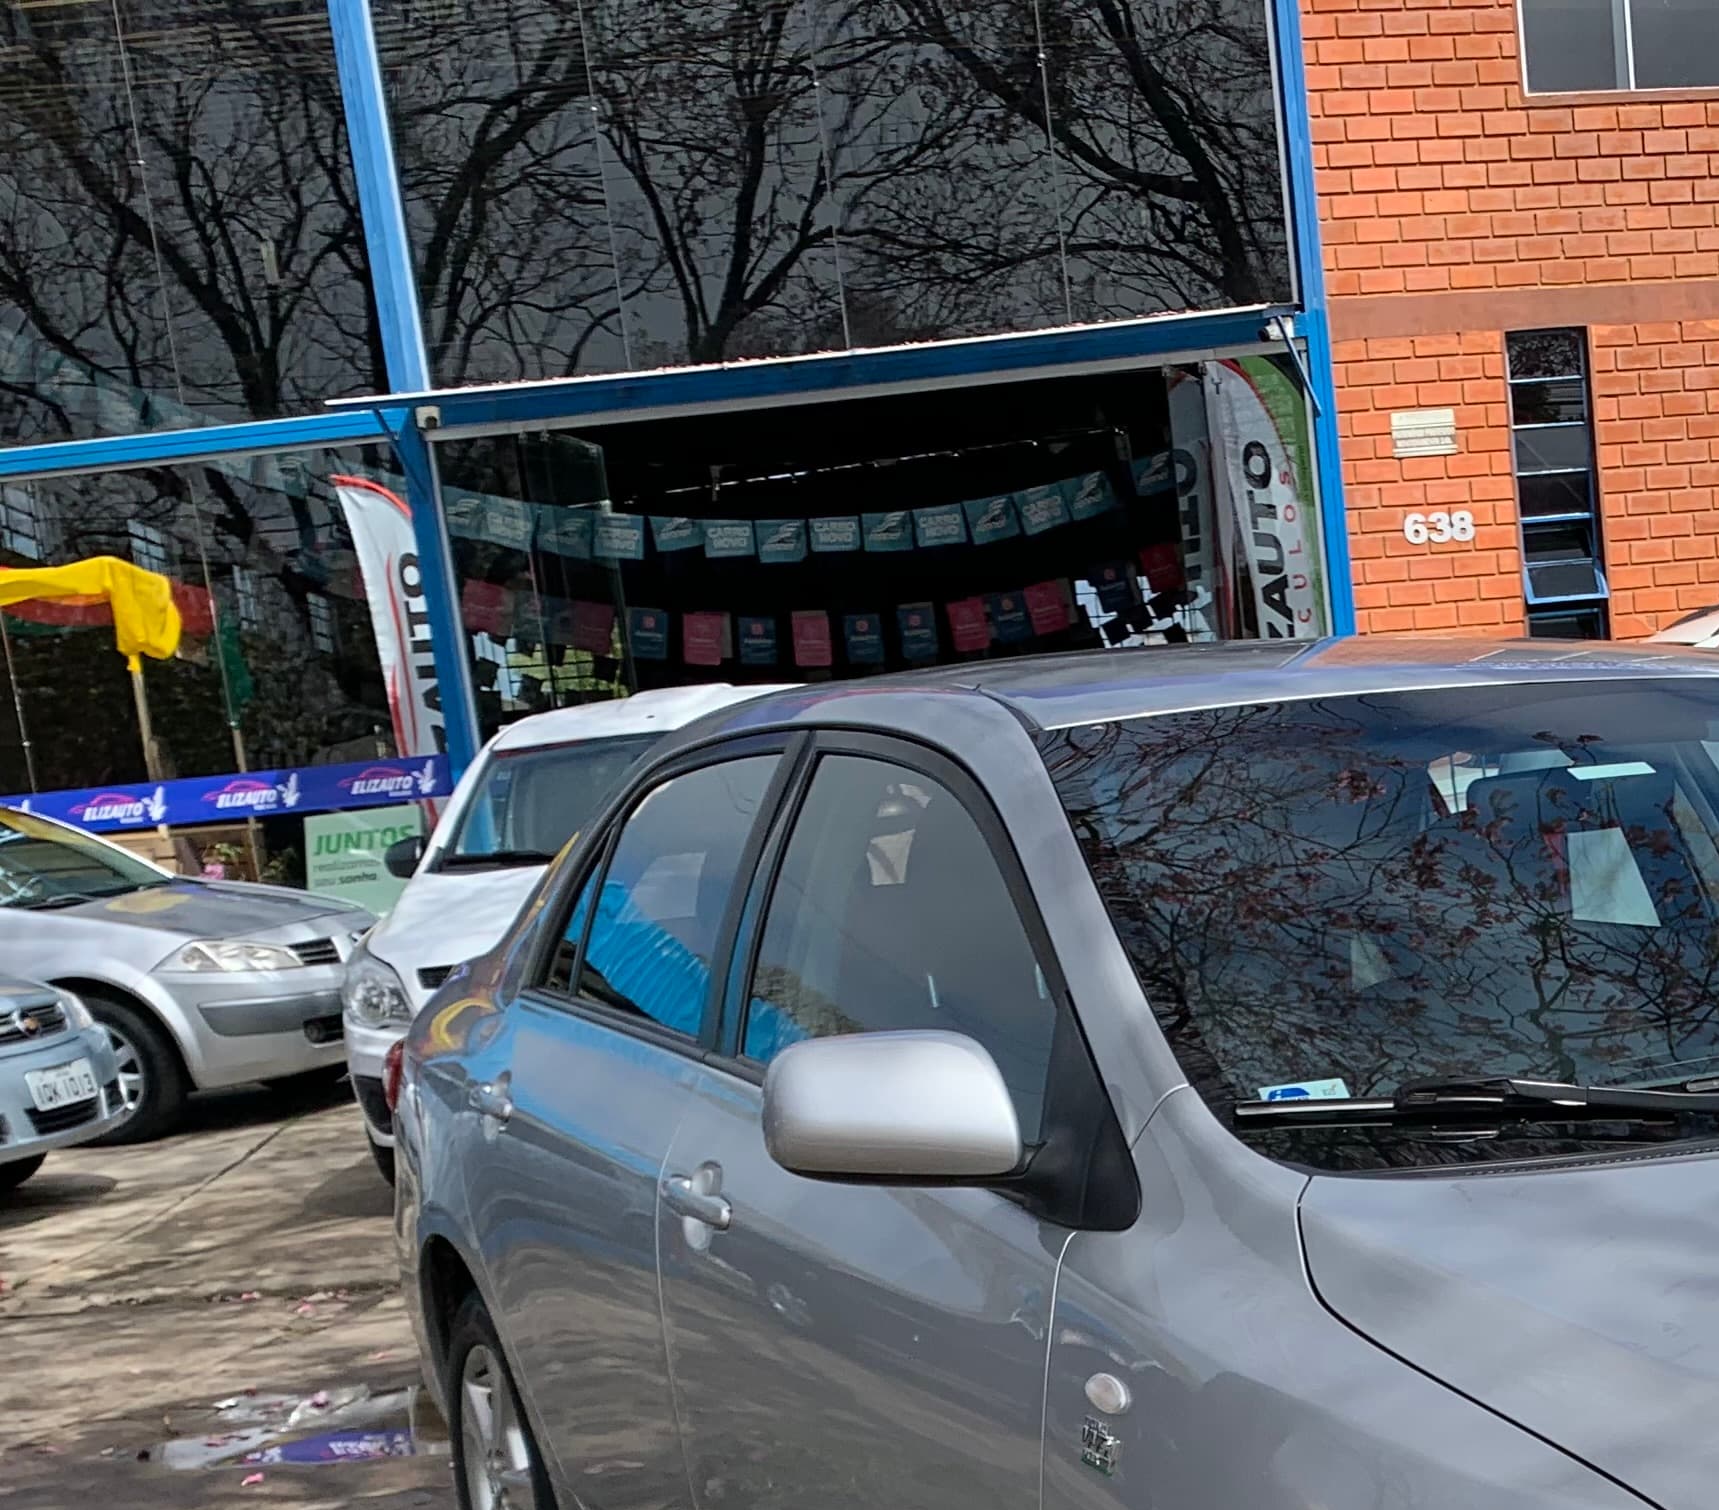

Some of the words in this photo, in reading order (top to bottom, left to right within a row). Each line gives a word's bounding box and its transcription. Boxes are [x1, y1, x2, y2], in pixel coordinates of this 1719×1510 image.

[1404, 510, 1475, 544] 638
[351, 776, 414, 795] ELIZAUTO
[216, 789, 278, 809] ELIZAUTO
[82, 802, 144, 822] ELIZAUTO
